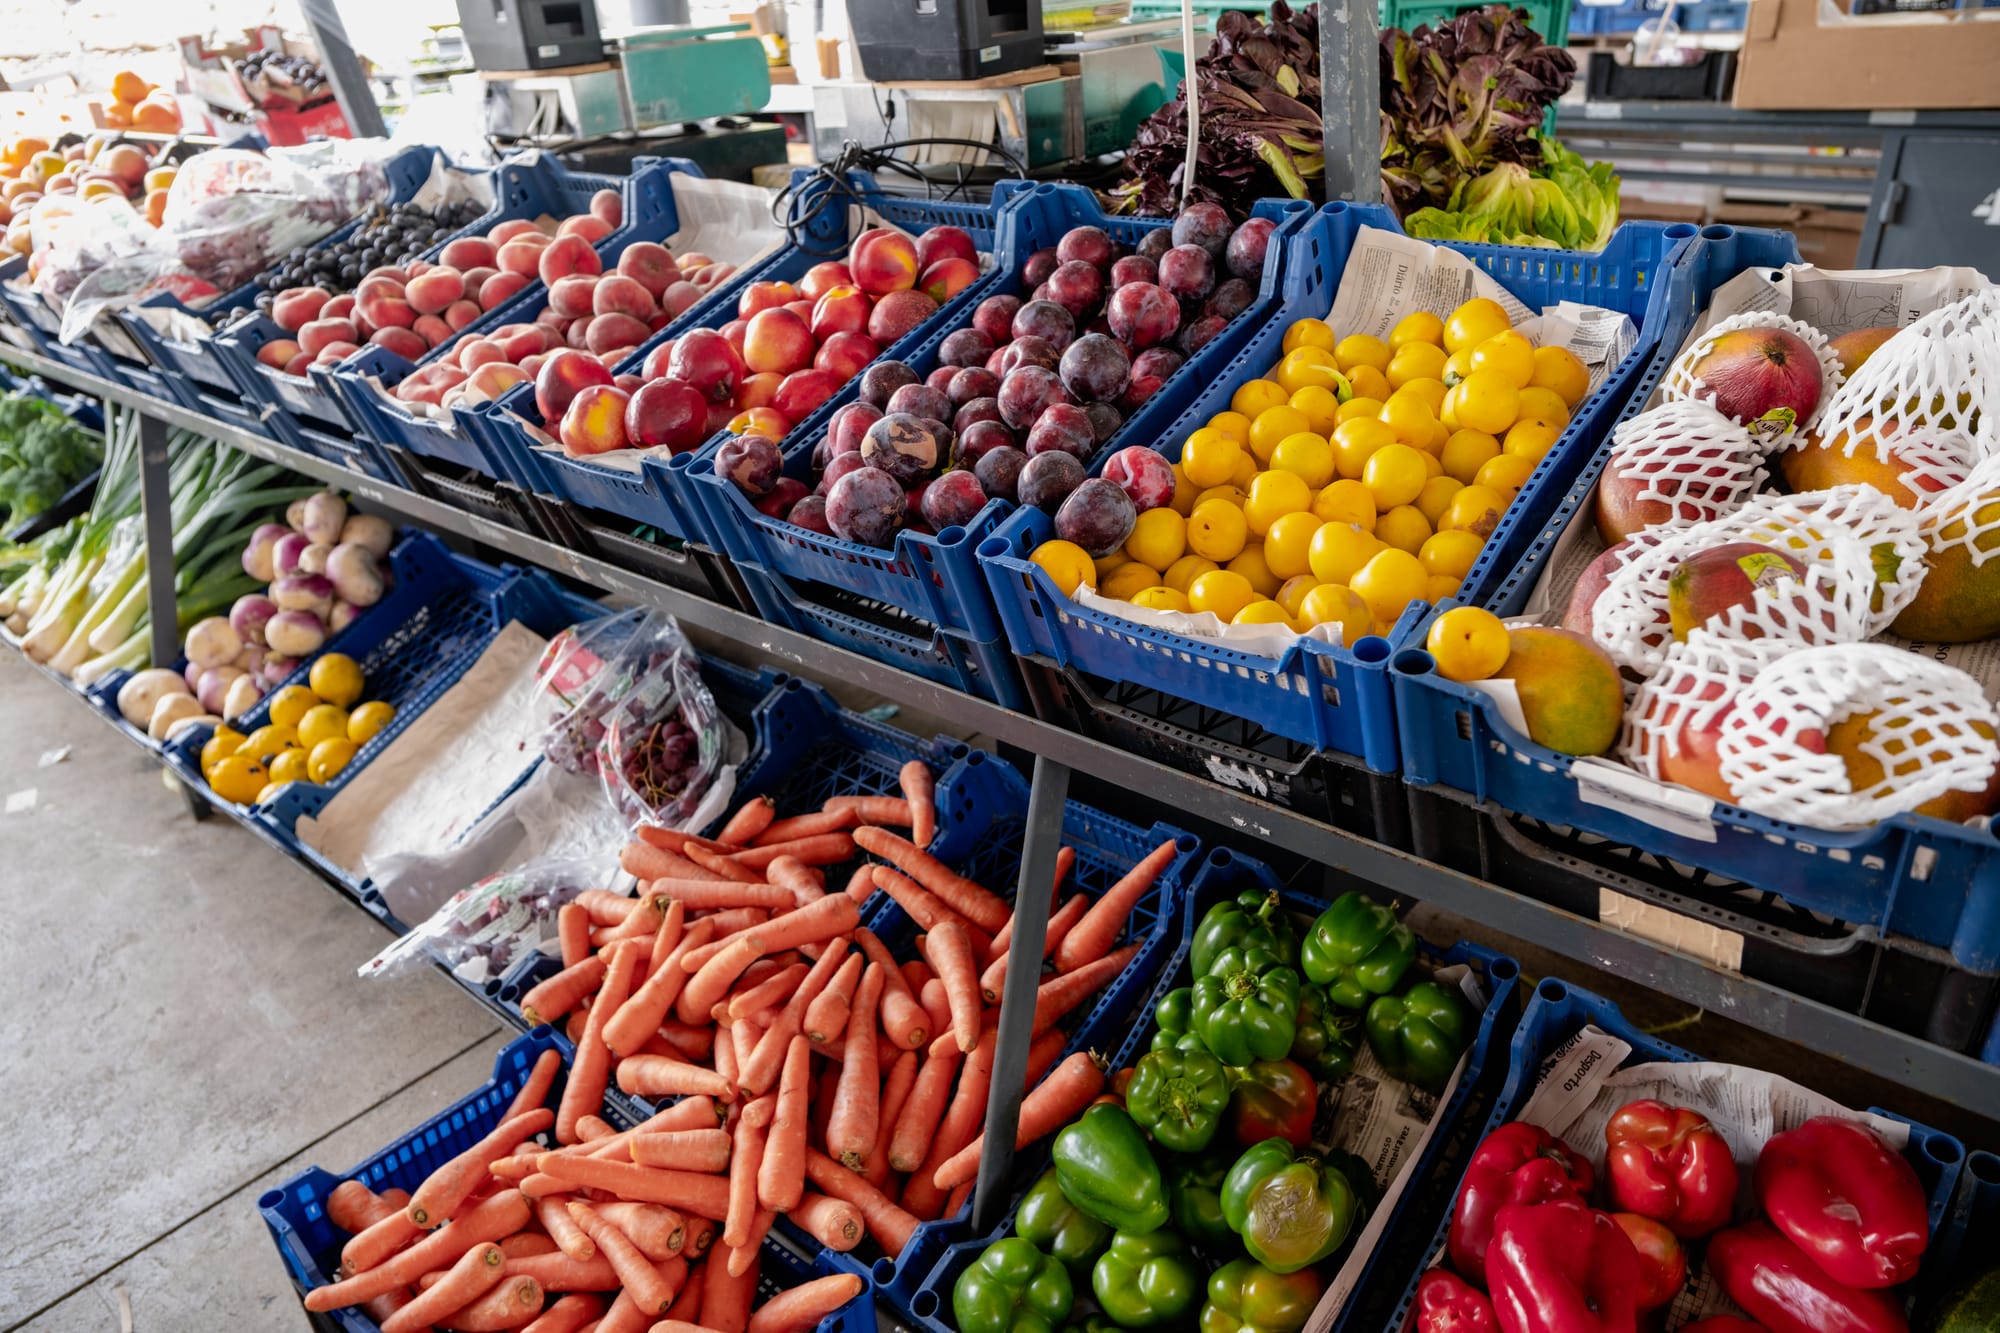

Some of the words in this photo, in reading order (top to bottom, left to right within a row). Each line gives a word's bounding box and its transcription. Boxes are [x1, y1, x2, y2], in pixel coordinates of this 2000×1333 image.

[1393, 264, 1408, 295] Diário
[1375, 309, 1394, 337] Açore
[1563, 1050, 1602, 1092] Desporto
